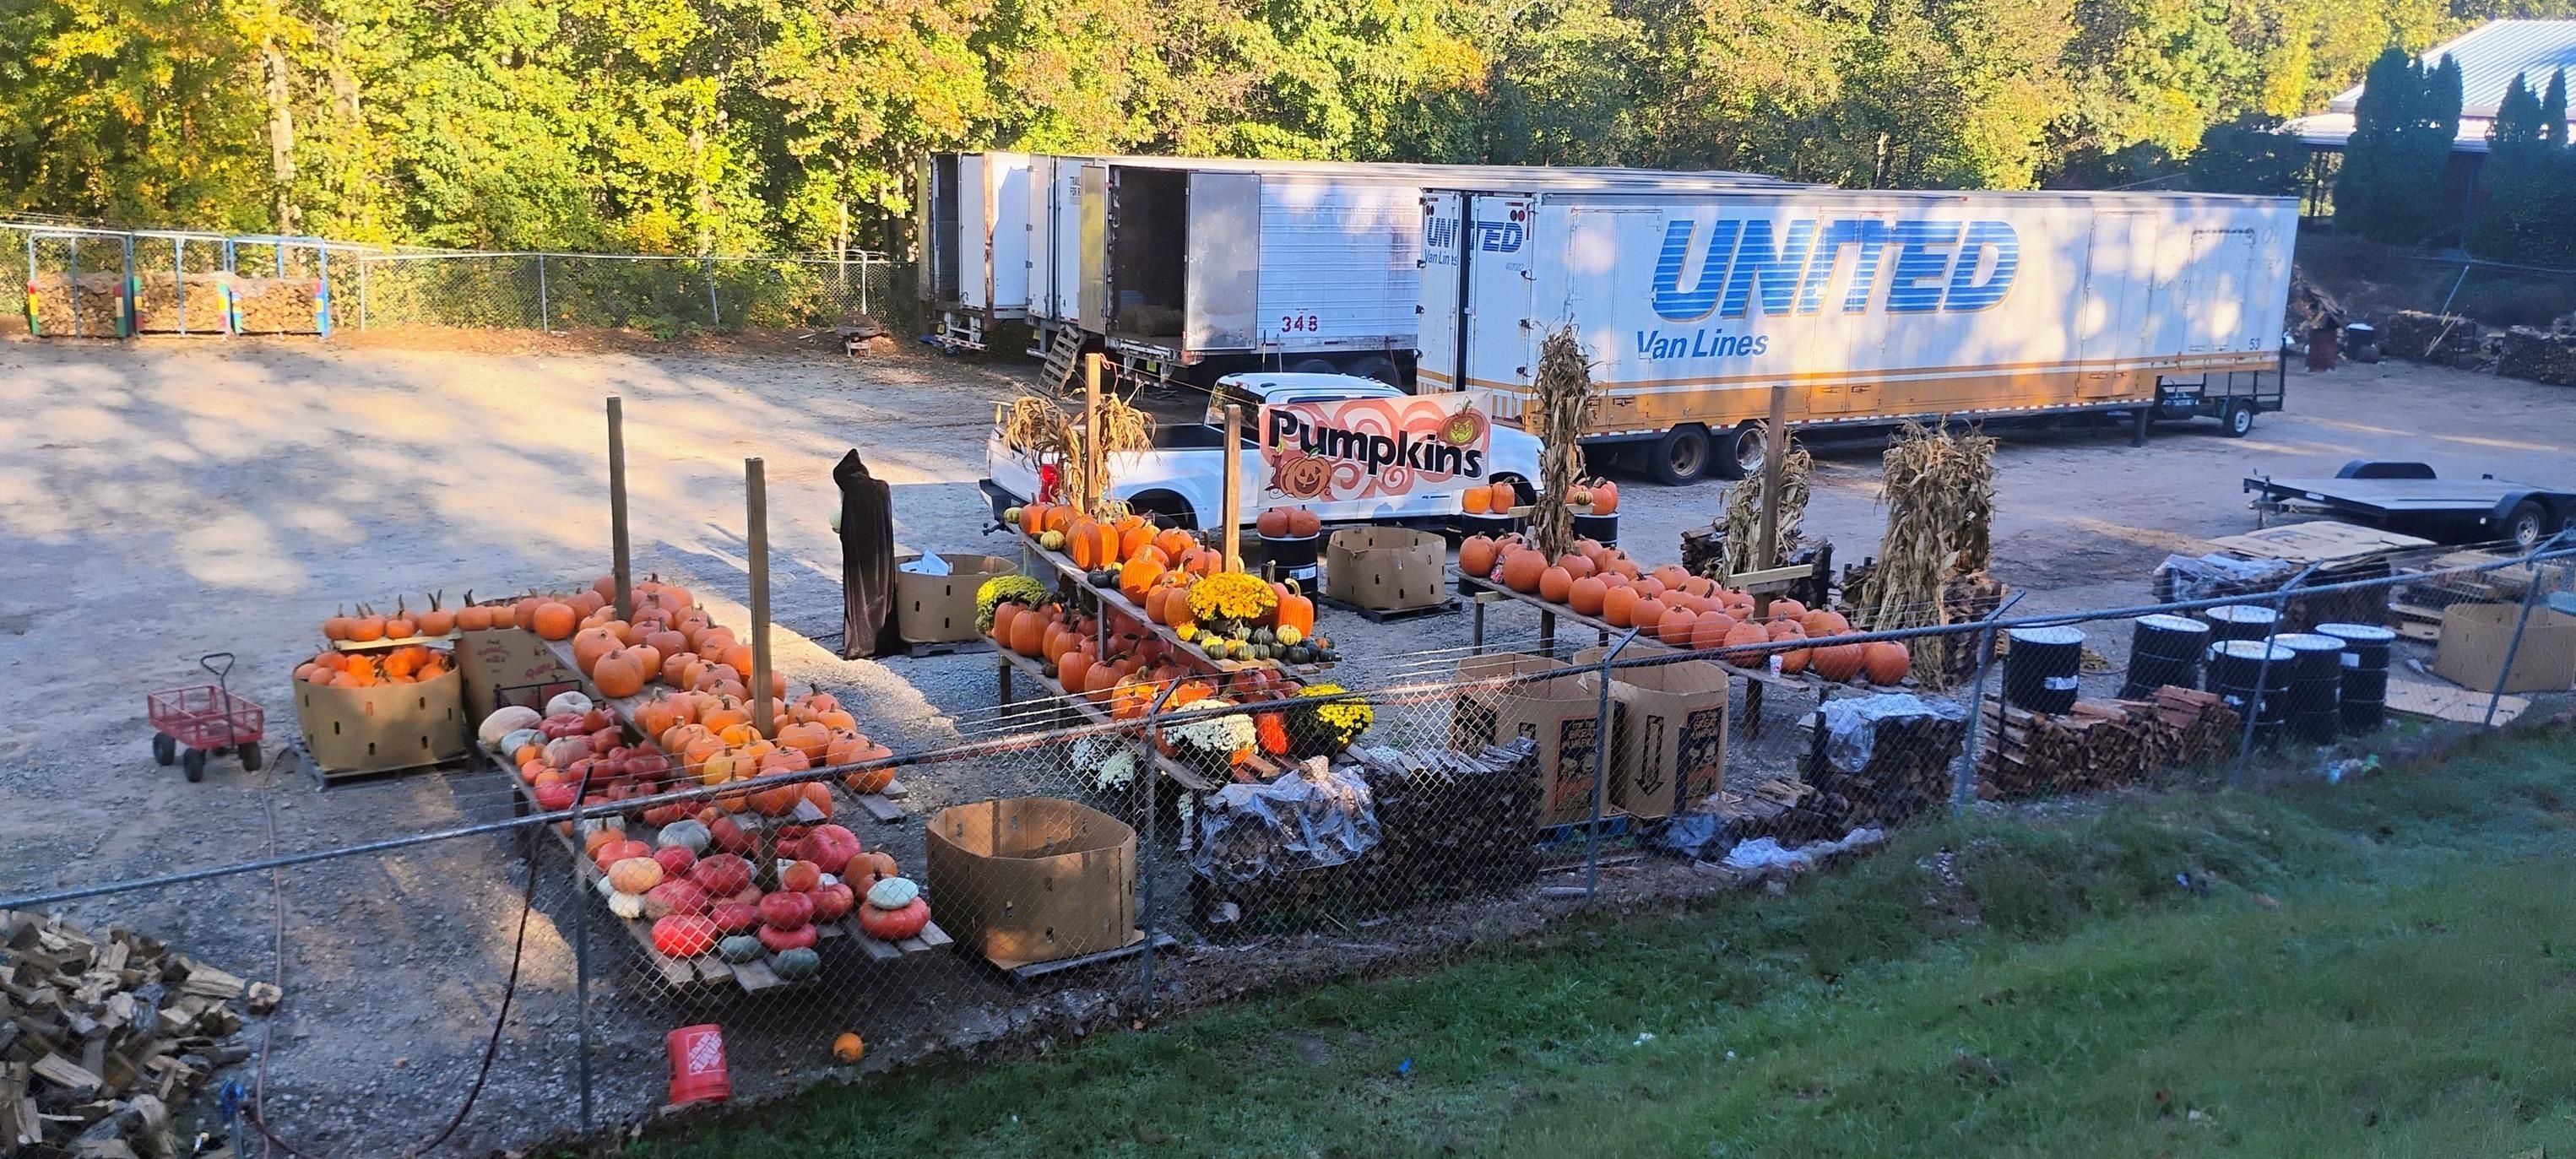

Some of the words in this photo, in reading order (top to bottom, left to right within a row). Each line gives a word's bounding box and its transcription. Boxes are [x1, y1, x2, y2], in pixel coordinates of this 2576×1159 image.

[1424, 249, 1438, 263] Van
[1652, 219, 2020, 323] UNITED
[1282, 315, 1318, 333] 348
[1636, 330, 1686, 360] Van
[1692, 328, 1769, 358] Lines
[2248, 338, 2261, 350] 53
[1269, 409, 1483, 479] Pumpkins
